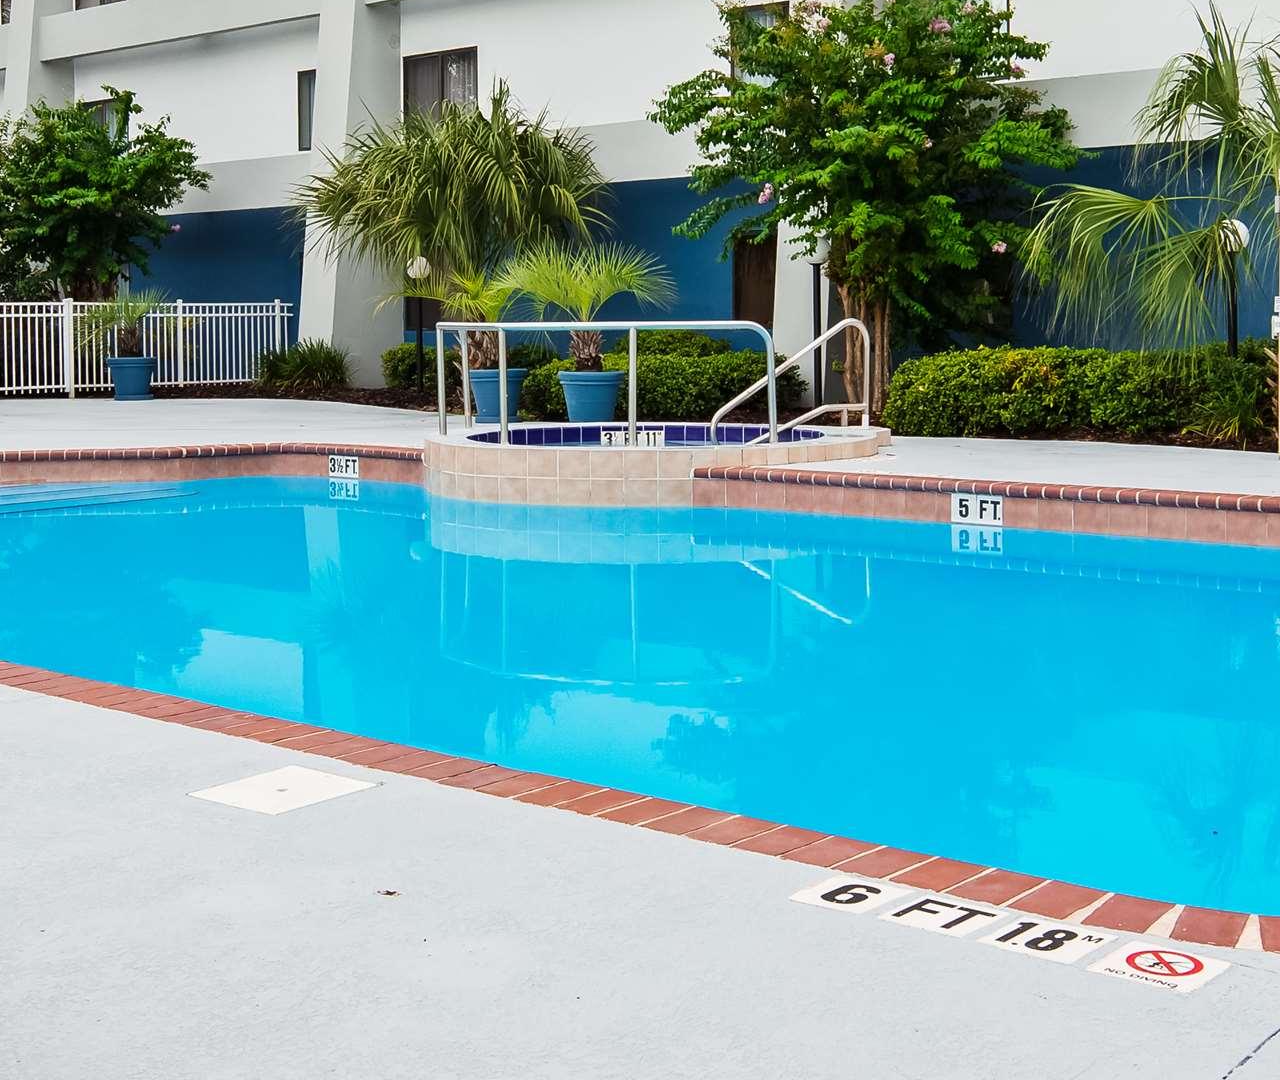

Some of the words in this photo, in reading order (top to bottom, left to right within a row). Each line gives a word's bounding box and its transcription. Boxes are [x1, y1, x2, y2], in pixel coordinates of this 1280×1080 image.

[958, 498, 969, 519] 5
[979, 499, 1001, 521] FT.
[820, 883, 882, 905] 6
[891, 898, 998, 929] FT
[1104, 967, 1126, 976] NO
[1129, 973, 1179, 989] DIVING
